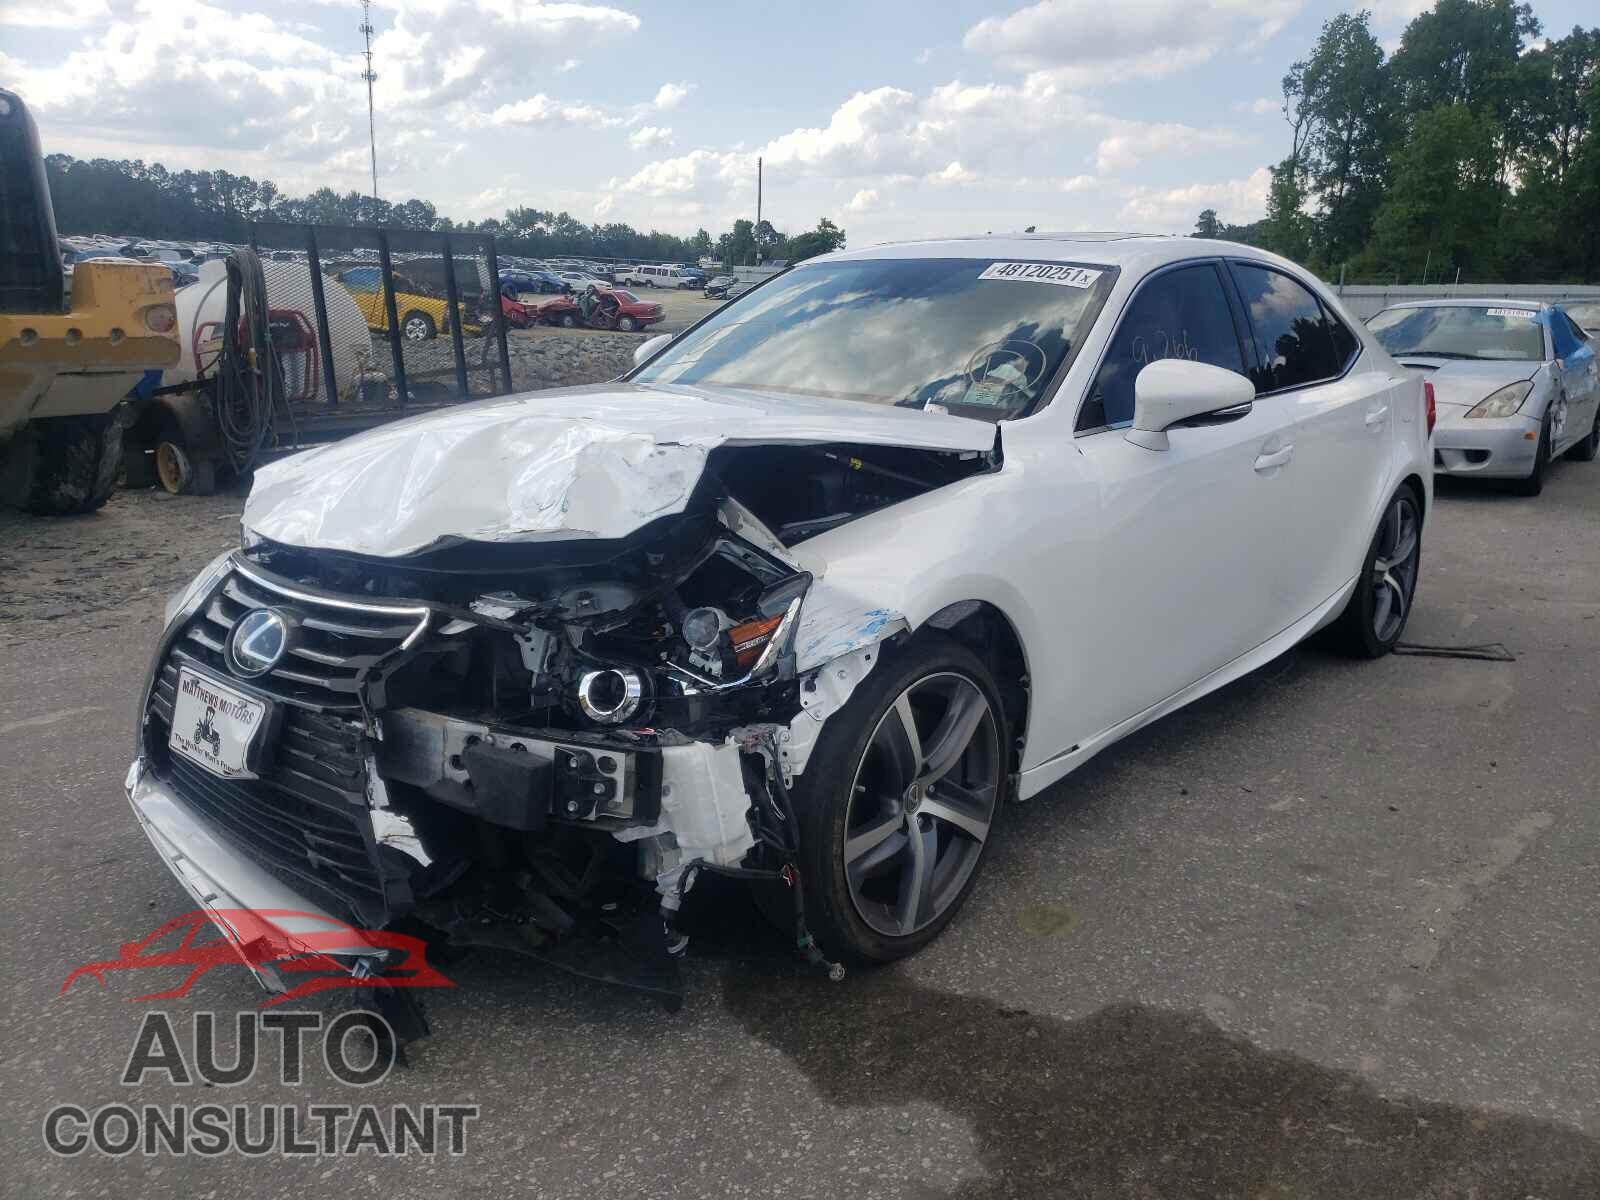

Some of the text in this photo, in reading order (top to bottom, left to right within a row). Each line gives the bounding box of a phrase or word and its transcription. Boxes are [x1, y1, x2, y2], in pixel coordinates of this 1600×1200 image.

[996, 263, 1084, 285] 48120251
[182, 680, 255, 725] MATTHEWS MOTORS
